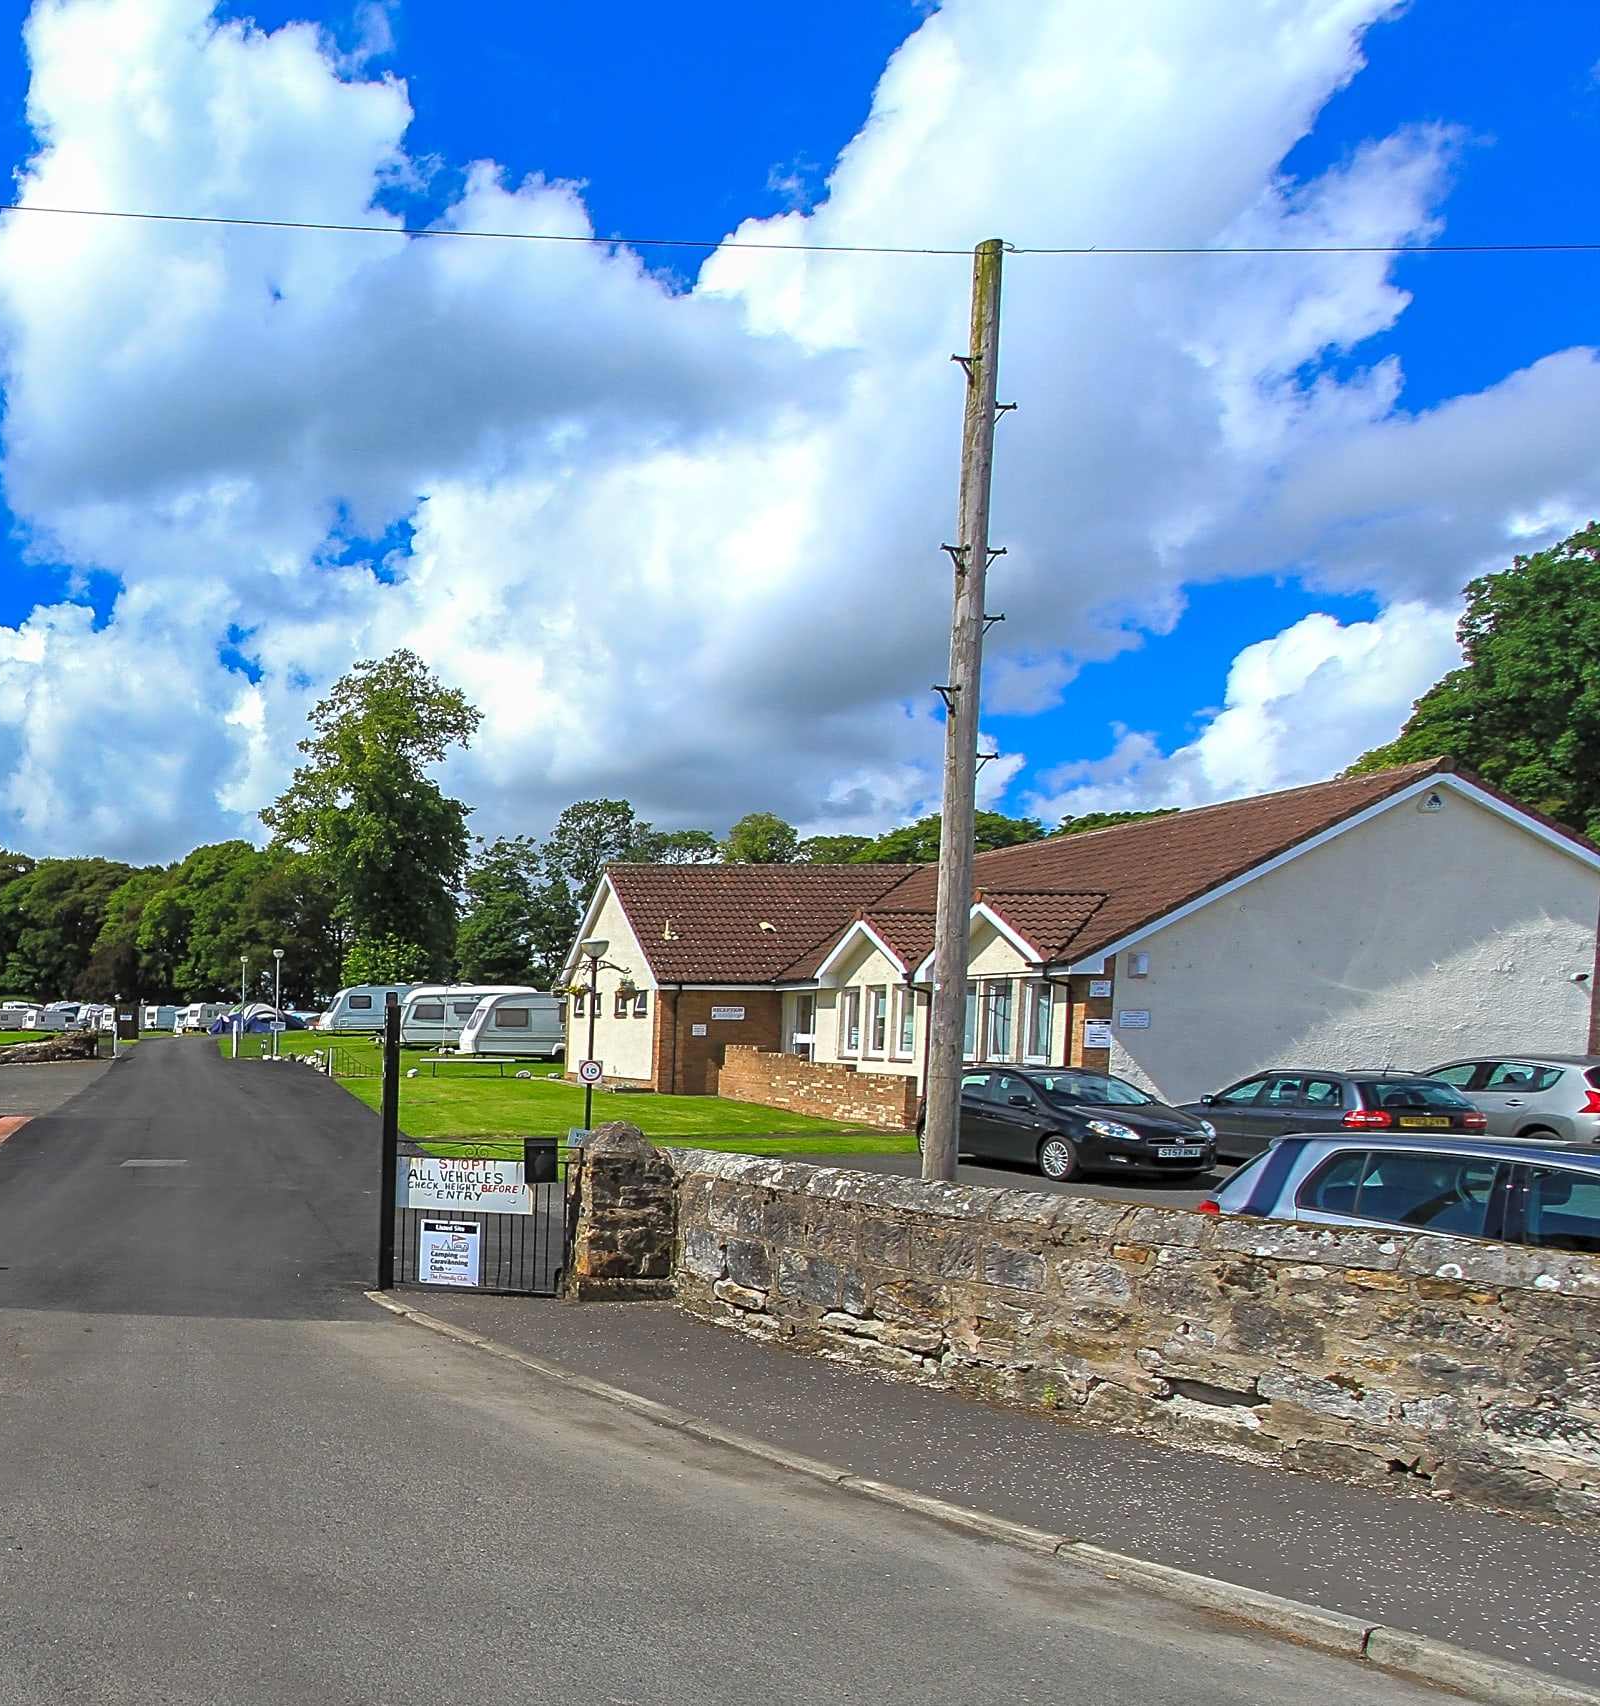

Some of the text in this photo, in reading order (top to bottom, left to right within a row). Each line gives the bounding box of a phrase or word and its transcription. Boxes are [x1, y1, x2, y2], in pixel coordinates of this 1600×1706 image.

[586, 1067, 598, 1075] 10
[1161, 1148, 1183, 1156] ST57
[439, 1159, 488, 1171] STOP!
[407, 1169, 435, 1181] ALL
[445, 1183, 478, 1192] HEIGHT
[481, 1184, 519, 1194] BEFORE
[436, 1190, 482, 1201] ENTRY
[430, 1251, 459, 1260] Camping
[430, 1258, 469, 1267] Caravanning
